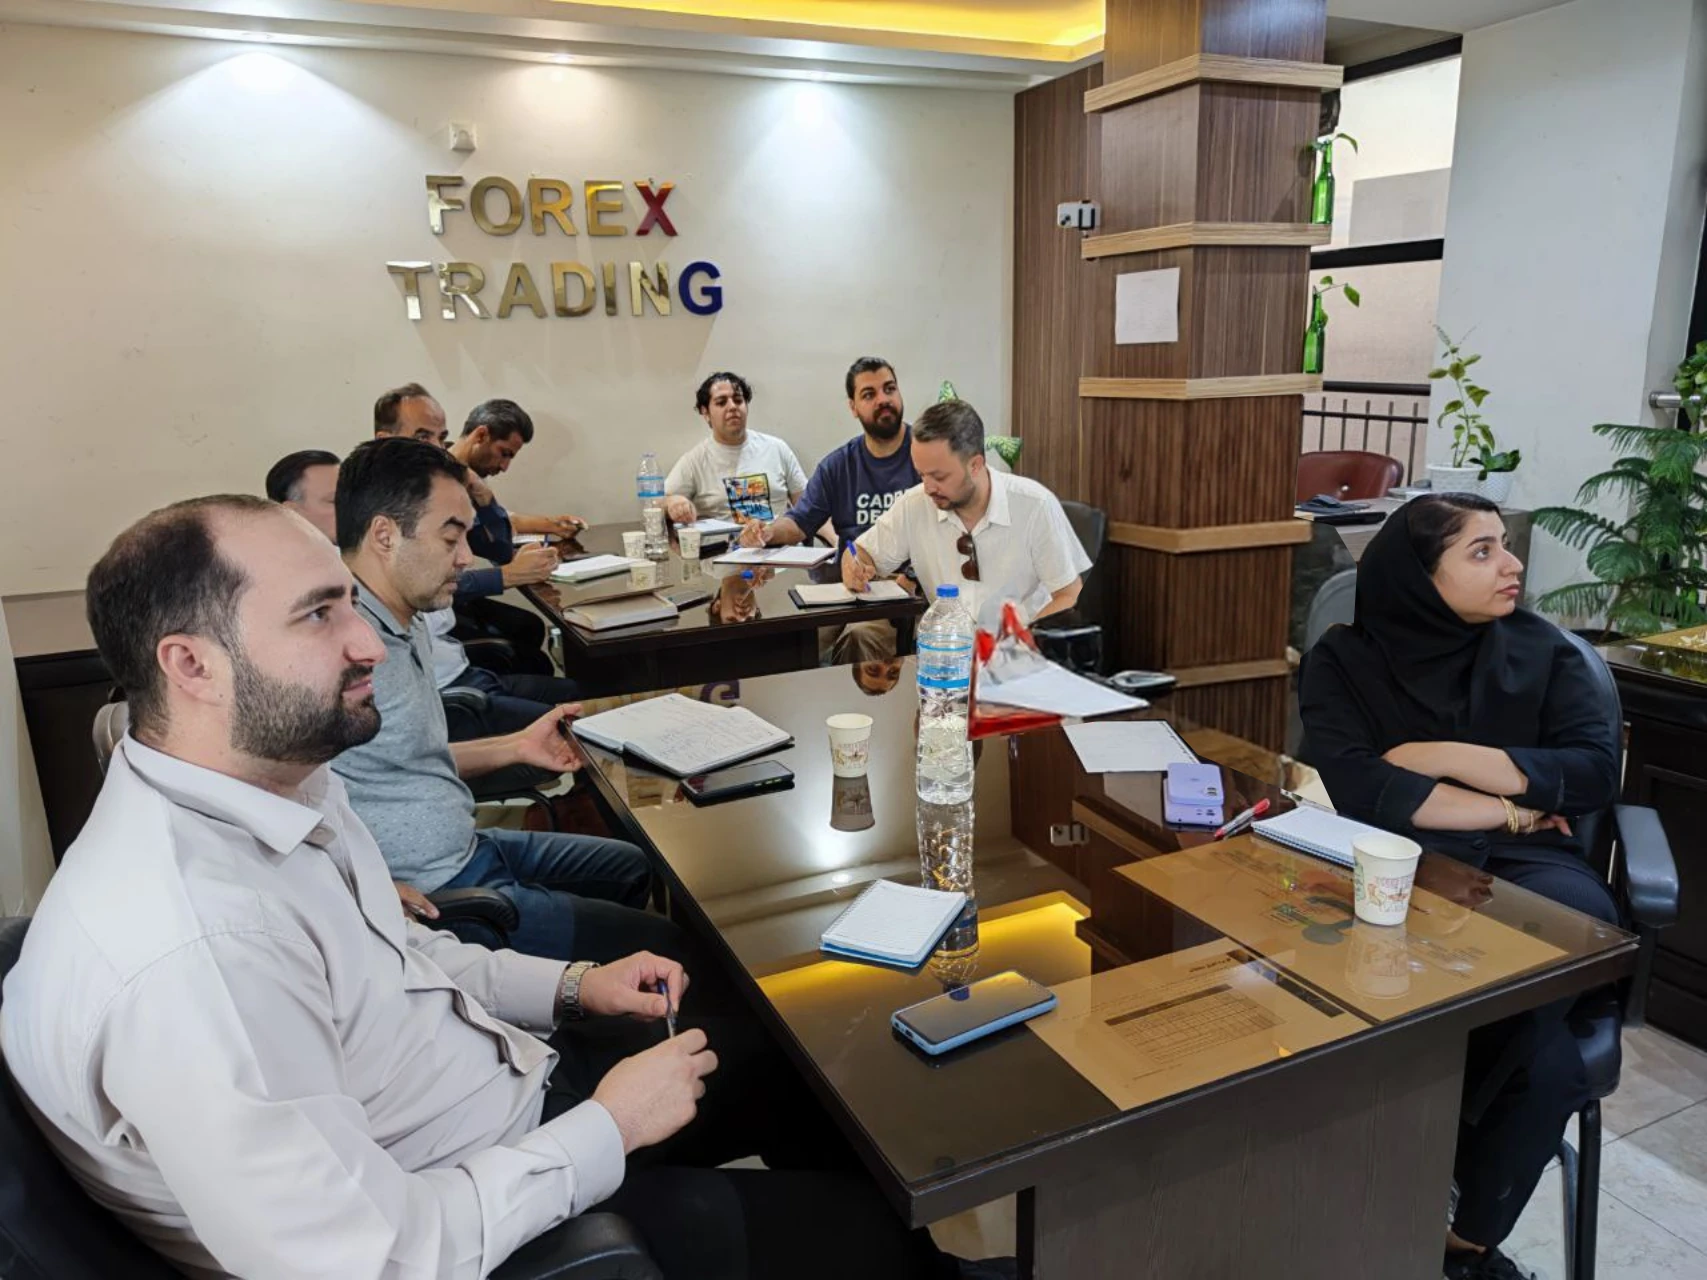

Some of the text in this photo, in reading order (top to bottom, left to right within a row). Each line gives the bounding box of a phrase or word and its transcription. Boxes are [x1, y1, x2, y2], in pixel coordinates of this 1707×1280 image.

[425, 174, 679, 237] FOREX
[386, 261, 723, 319] TRADING
[856, 509, 887, 525] DE
